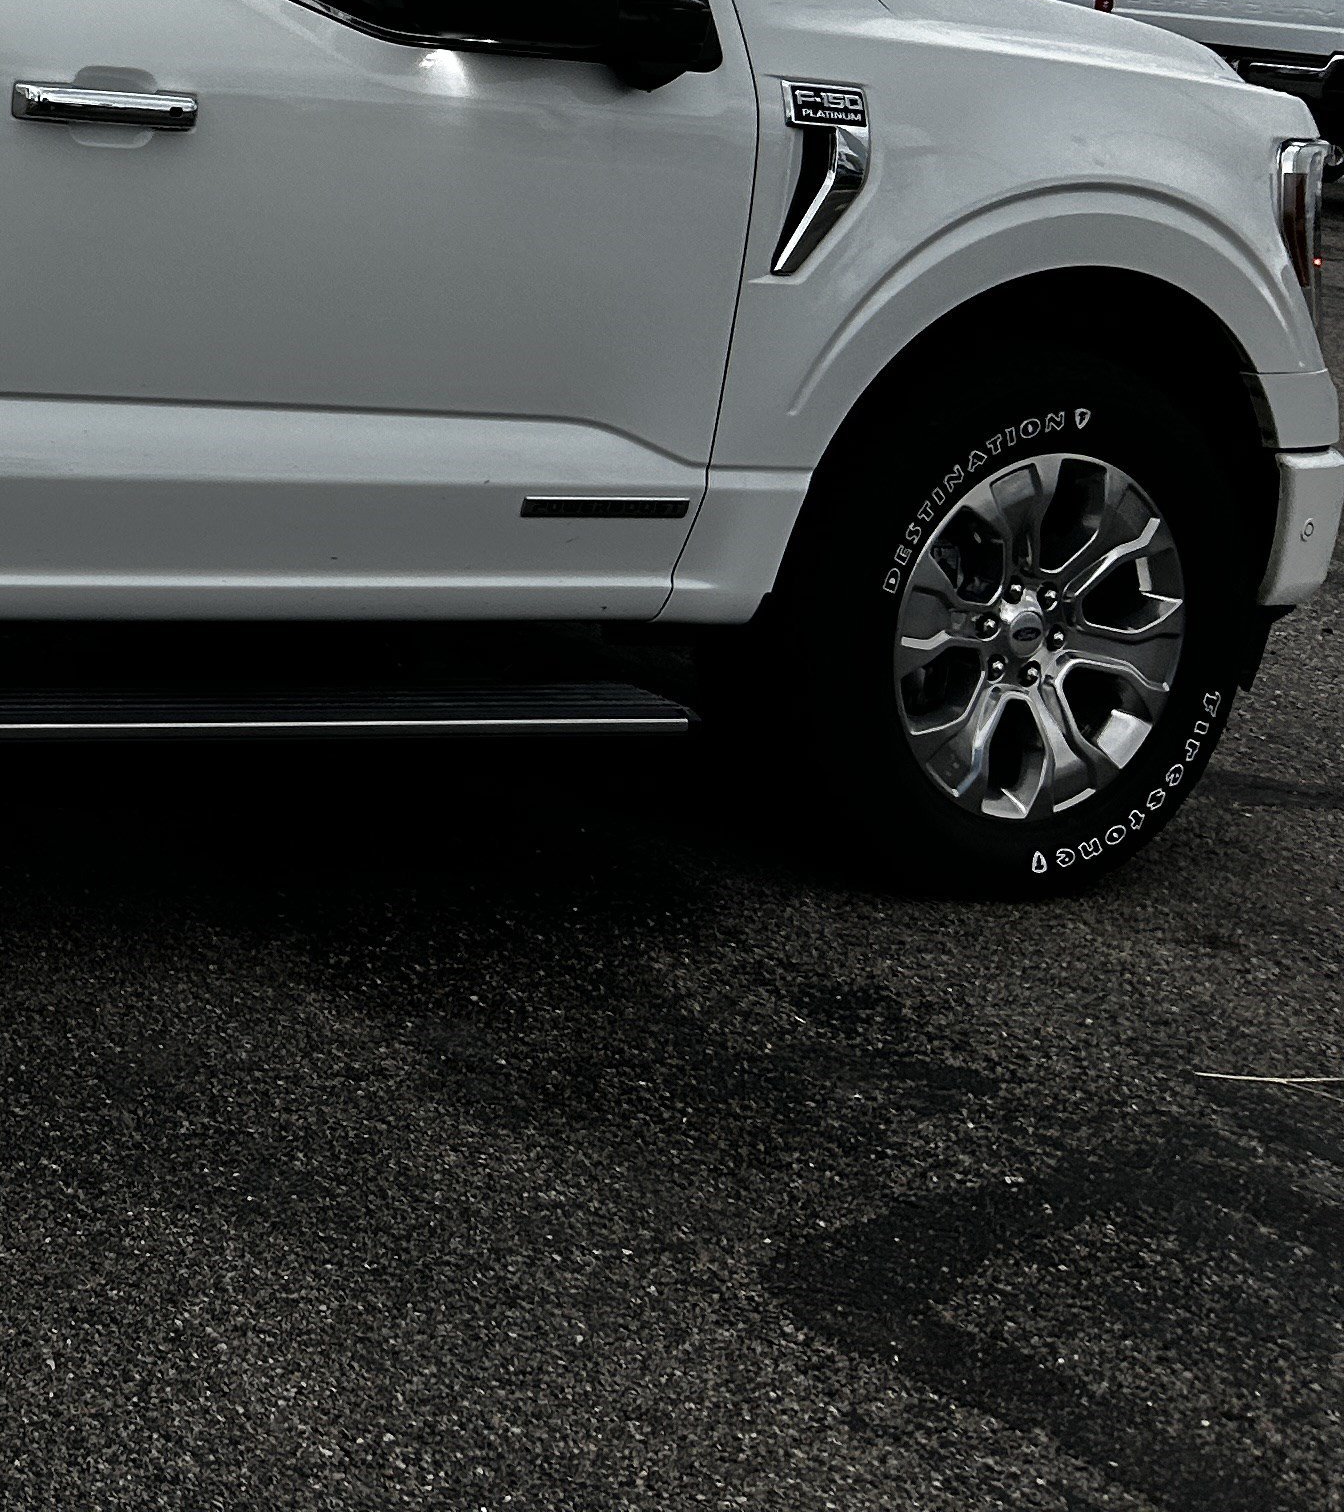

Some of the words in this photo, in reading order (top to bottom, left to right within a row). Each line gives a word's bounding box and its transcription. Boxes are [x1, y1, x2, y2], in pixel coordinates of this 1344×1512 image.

[794, 90, 864, 110] F-150
[802, 108, 862, 121] PLATINUM
[882, 411, 1065, 594] DESTINATION
[1055, 690, 1221, 868] Firestone
